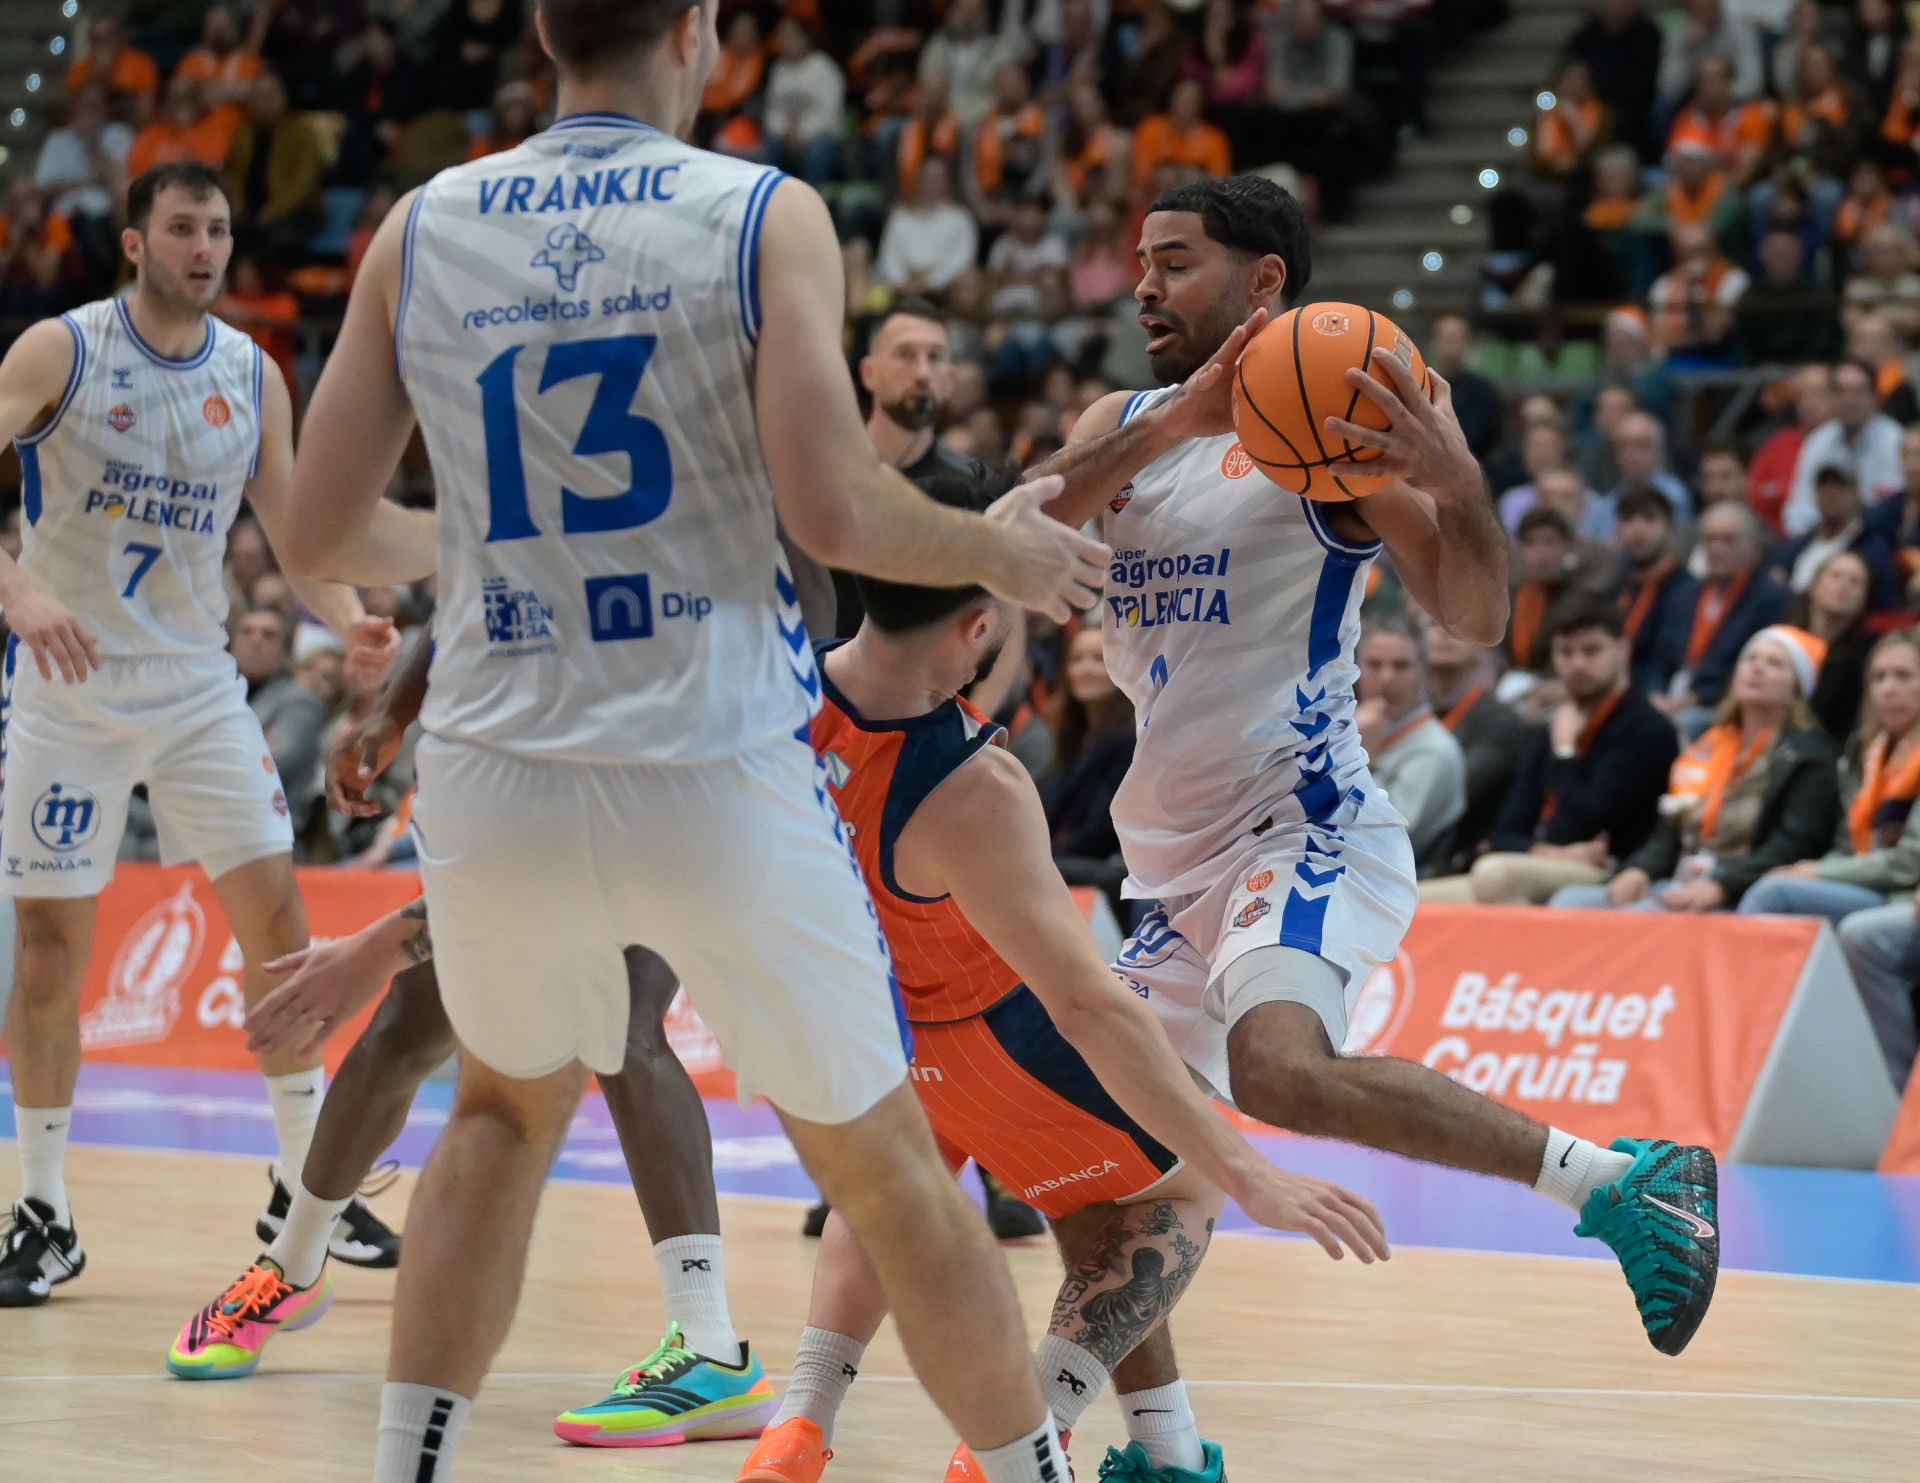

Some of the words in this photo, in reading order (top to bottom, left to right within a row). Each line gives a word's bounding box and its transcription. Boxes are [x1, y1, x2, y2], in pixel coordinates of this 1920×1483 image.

[463, 296, 590, 330] recoletas
[602, 284, 672, 314] salud
[476, 334, 673, 542] 13
[102, 468, 217, 502] agropal
[121, 541, 164, 598] 7
[1110, 548, 1231, 589] agropal
[662, 592, 712, 621] Dip
[1441, 972, 1676, 1047] Básquet
[1421, 1035, 1628, 1105] Coruña
